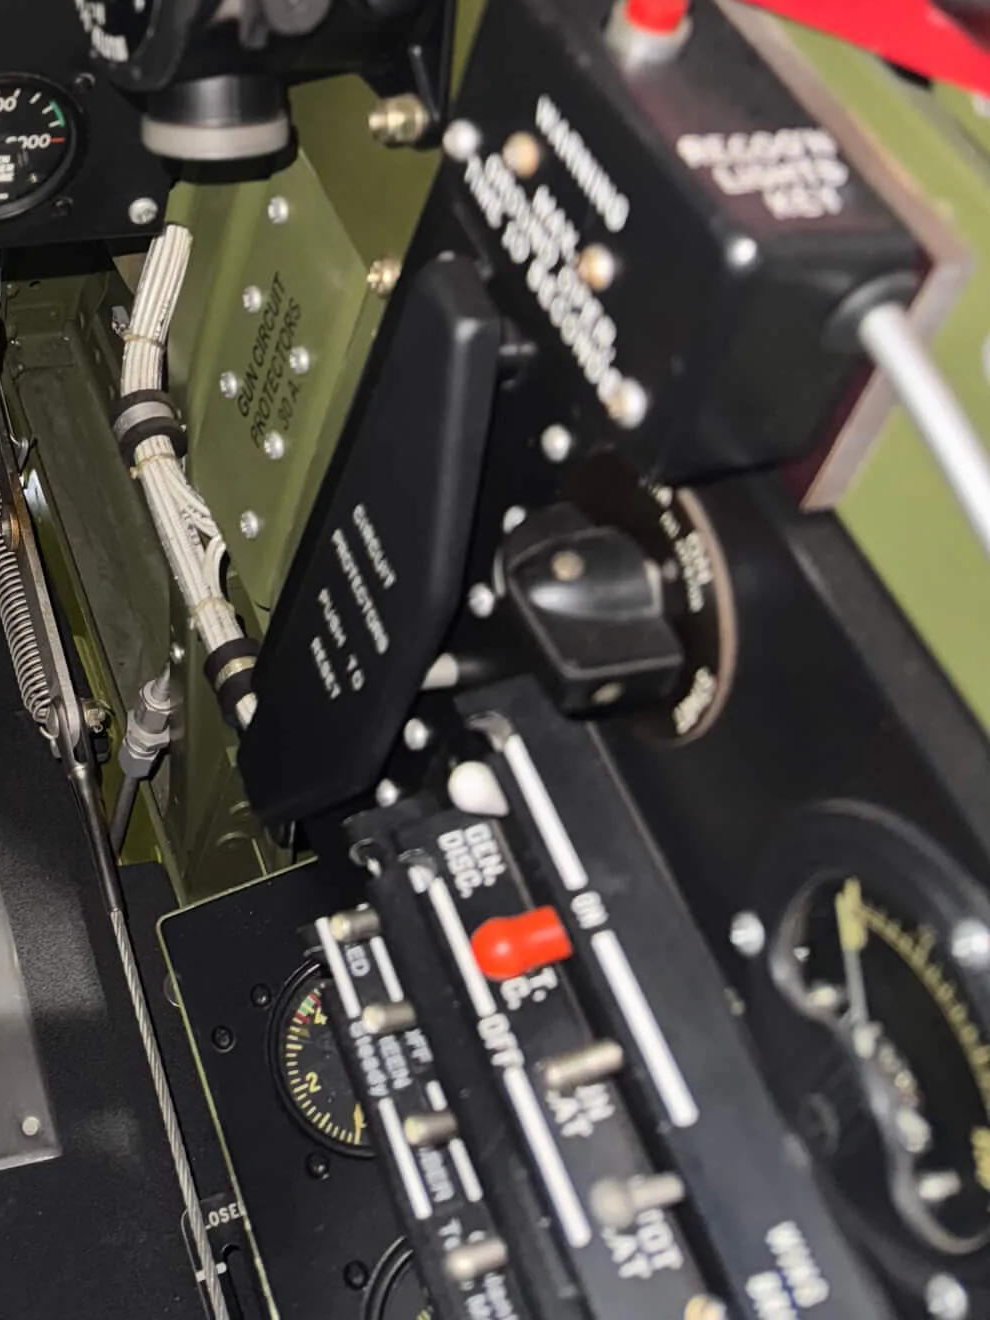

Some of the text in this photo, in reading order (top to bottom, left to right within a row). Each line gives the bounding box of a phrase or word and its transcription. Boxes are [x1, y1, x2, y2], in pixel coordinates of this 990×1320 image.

[237, 270, 285, 418] GUN CIRCUIT
[250, 297, 301, 449] PROTECTORS
[353, 503, 396, 590] CIRCUIT
[332, 528, 390, 655] PROTECTORS
[318, 587, 365, 692] PUSH TO
[438, 829, 483, 899] DISC.
[464, 822, 507, 887] GEN.
[570, 890, 609, 929] ON
[314, 1007, 328, 1025] 4
[477, 1012, 525, 1067] OFF
[306, 1072, 322, 1093] 2
